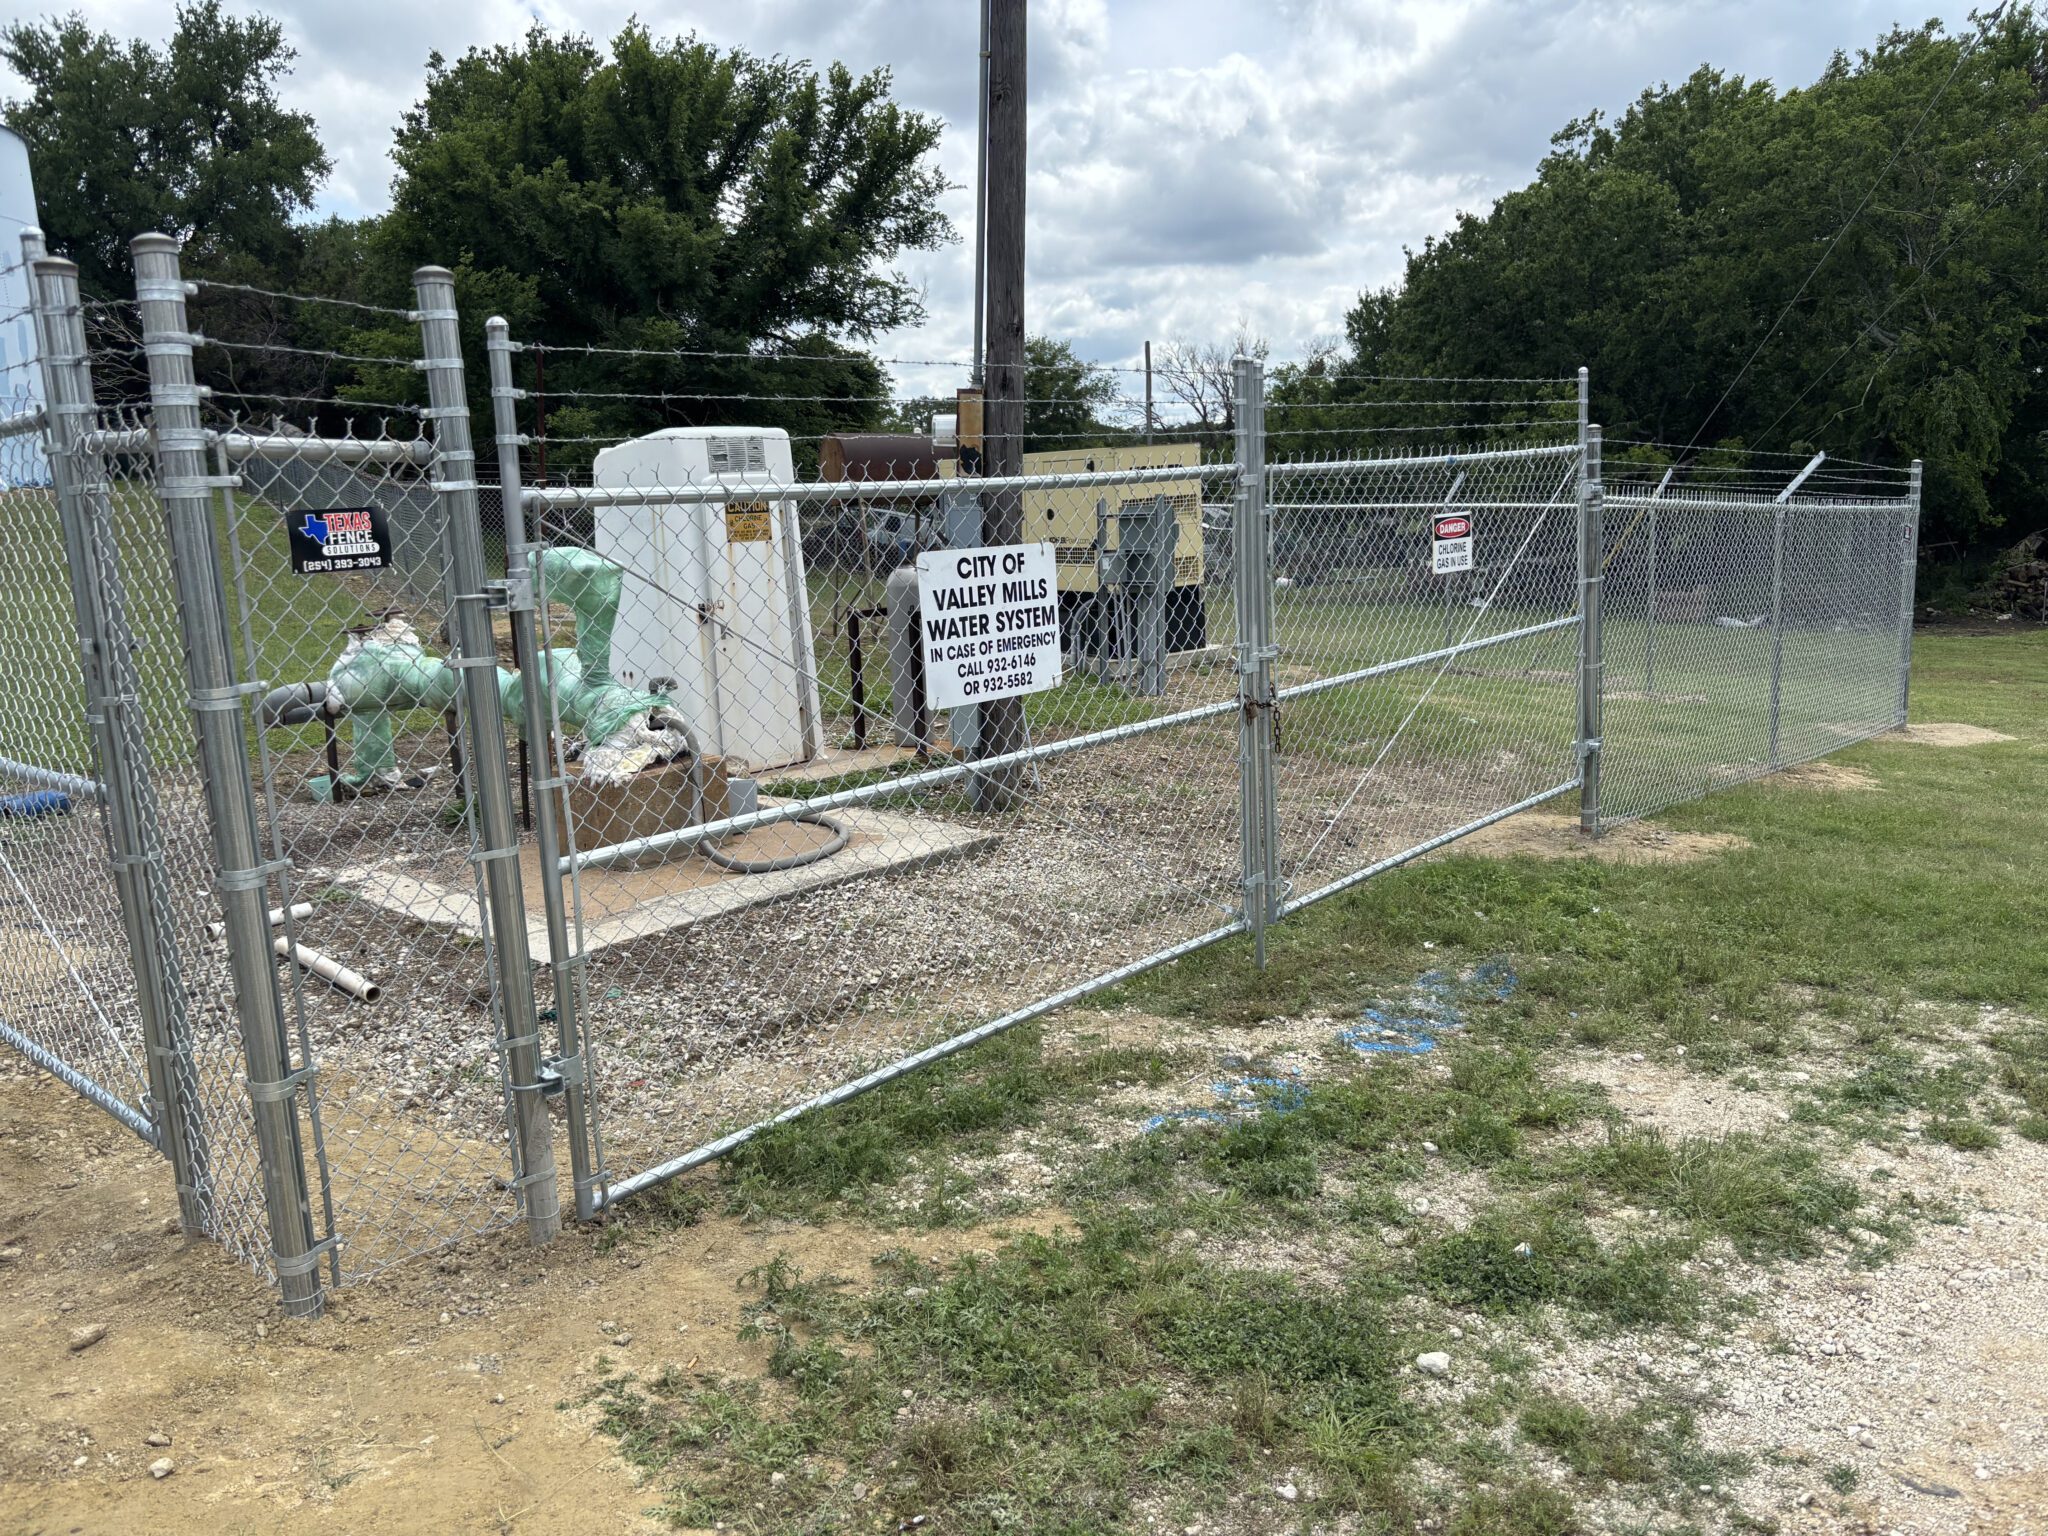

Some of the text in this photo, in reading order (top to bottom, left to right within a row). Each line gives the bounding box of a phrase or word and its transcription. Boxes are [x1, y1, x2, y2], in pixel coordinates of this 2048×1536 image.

[727, 500, 768, 512] CAUTION
[323, 512, 372, 533] TEXAS
[1440, 522, 1466, 534] DANGER
[329, 530, 374, 544] FENCE
[327, 544, 376, 554] SOLUTIONS
[1438, 542, 1467, 555] CHLORINE
[303, 556, 381, 572] (254) 393-3043
[957, 552, 1025, 579] CITY OF
[1437, 555, 1468, 569] GAS IN USE
[933, 578, 1047, 611] VALLEY MILLS
[927, 605, 1056, 641] WATER SYSTEM
[931, 631, 1056, 662] IN CASE OF EMERGENCY
[958, 653, 1036, 678] CALL 932-6146
[964, 671, 1033, 696] OR 932-5582
